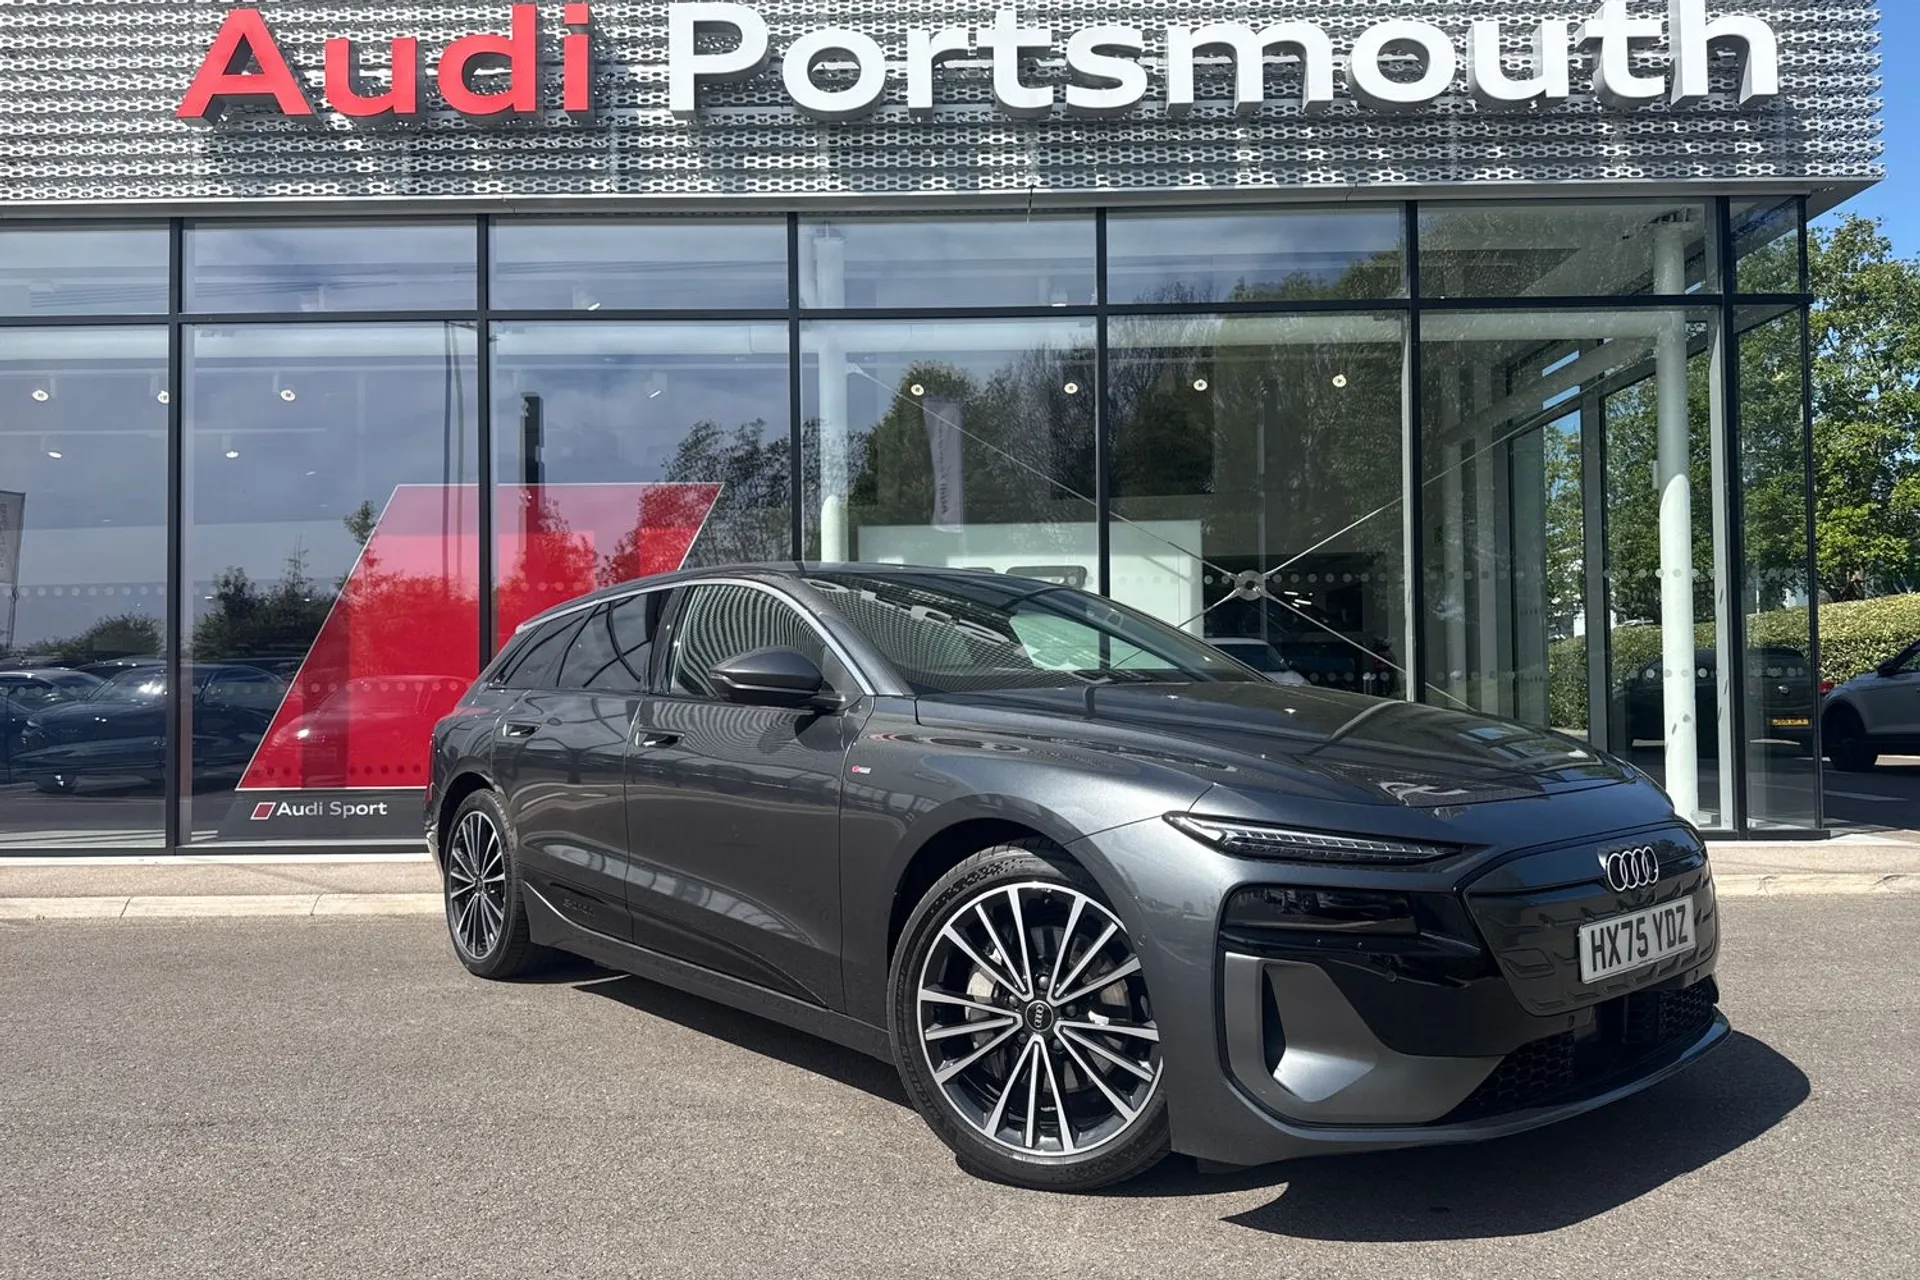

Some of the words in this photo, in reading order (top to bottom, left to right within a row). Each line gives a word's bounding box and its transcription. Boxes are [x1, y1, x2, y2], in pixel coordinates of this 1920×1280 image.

[180, 3, 589, 118] Audi
[669, 0, 1779, 114] Portsmouth
[276, 801, 323, 816] Audi
[329, 801, 388, 819] Sport
[1590, 916, 1649, 973] HX75
[1652, 904, 1688, 952] YDZ
